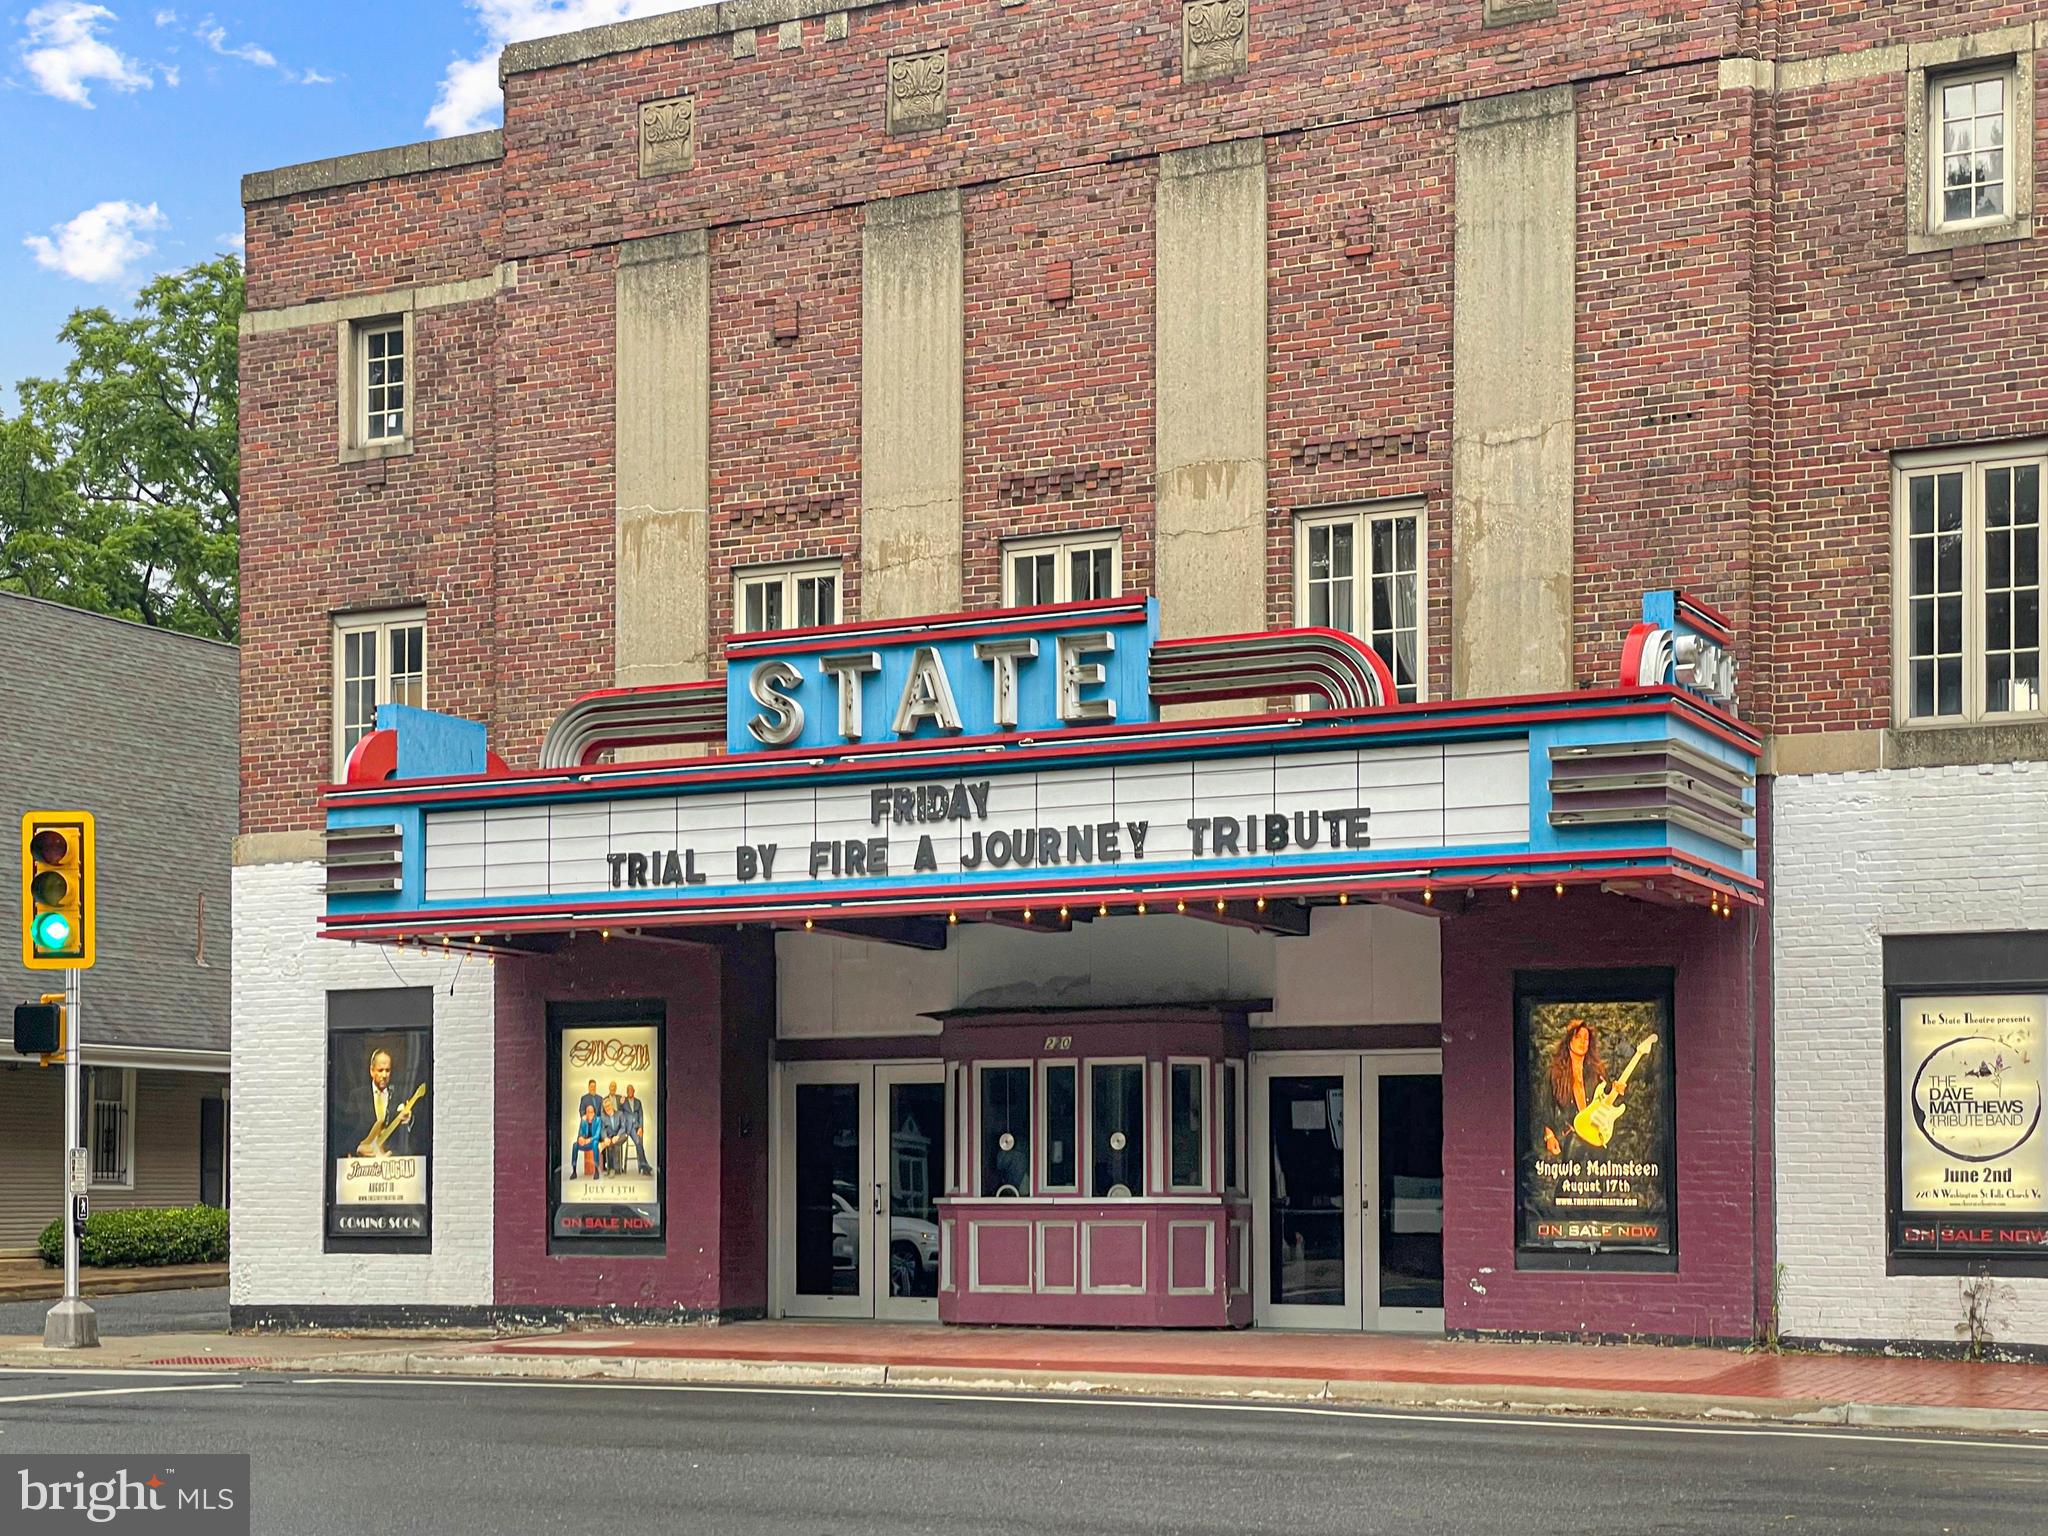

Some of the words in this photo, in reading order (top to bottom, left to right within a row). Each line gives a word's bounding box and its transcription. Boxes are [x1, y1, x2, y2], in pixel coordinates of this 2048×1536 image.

[748, 631, 1116, 744] STATE
[870, 781, 990, 824] FRIDAY
[607, 849, 706, 887] TRIAL
[736, 843, 777, 881] BY
[809, 837, 888, 876] FIRE
[913, 835, 938, 871] A
[961, 820, 1148, 868] JOURNEY
[1187, 807, 1371, 856] TRIBUTE
[1922, 1014, 1936, 1025] The
[1938, 1012, 1961, 1025] State
[1964, 1012, 1995, 1024] Theatre
[1997, 1016, 2031, 1025] presents
[1928, 1075, 1957, 1088] THE
[1929, 1087, 1974, 1100] DAVE
[1930, 1100, 2024, 1114] MATTHEWS
[1930, 1114, 1985, 1127] TRIBUTE
[1986, 1114, 2023, 1127] BAND
[1587, 1160, 1658, 1177] Malmsteen
[1944, 1168, 1979, 1183] June
[1983, 1167, 2012, 1182] 2nd
[368, 1182, 388, 1192] AUGUST
[584, 1184, 606, 1195] JULY
[611, 1186, 635, 1194] 13TH
[1562, 1180, 1602, 1194] August
[1606, 1180, 1630, 1192] 17th
[340, 1217, 386, 1228] COMING
[388, 1217, 420, 1228] SOON
[561, 1217, 582, 1228] ON
[585, 1216, 619, 1228] SALE
[623, 1218, 654, 1228] NOW
[1538, 1225, 1562, 1236] ON
[1568, 1224, 1612, 1237] SALE
[1618, 1225, 1658, 1236] NOW
[1904, 1229, 1935, 1241] ON
[1941, 1229, 1993, 1241] SALE
[2000, 1229, 2048, 1242] NOW
